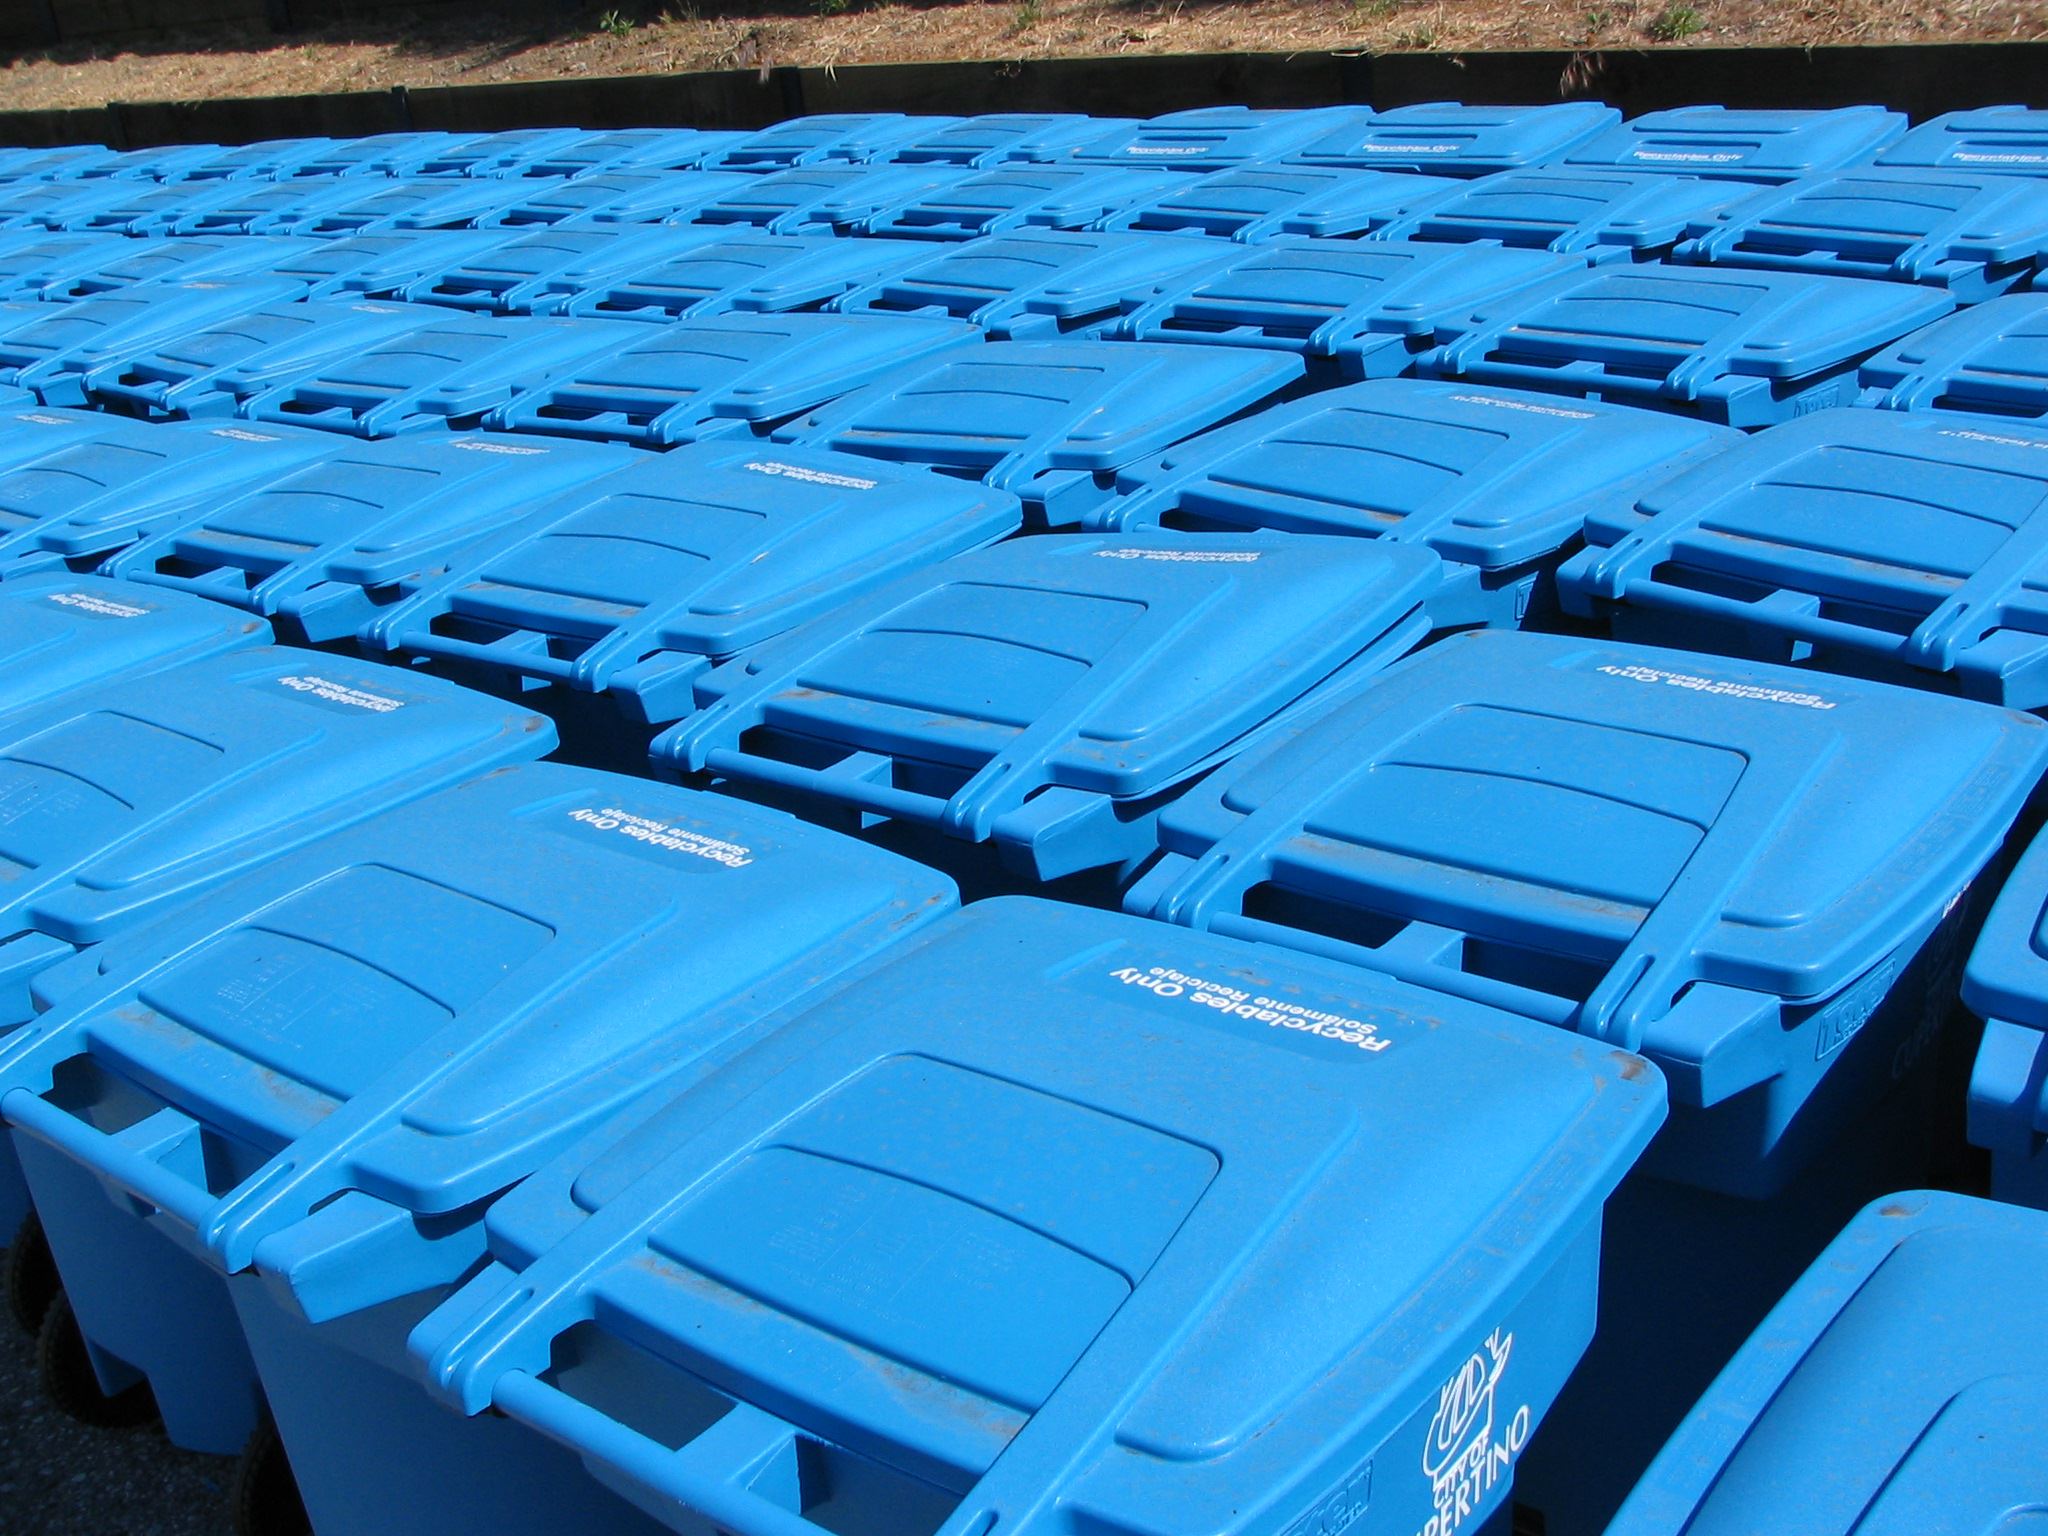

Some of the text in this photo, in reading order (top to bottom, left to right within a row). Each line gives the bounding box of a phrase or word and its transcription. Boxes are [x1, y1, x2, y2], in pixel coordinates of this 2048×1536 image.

[1596, 665, 1837, 709] Recyclables Only
[568, 808, 753, 868] Recyclables Only
[1109, 967, 1392, 1051] Recyclables Only
[1149, 967, 1250, 1001] Reciclaje
[1416, 1404, 1529, 1536] PERTINO
[1434, 1437, 1489, 1509] CITY OF
